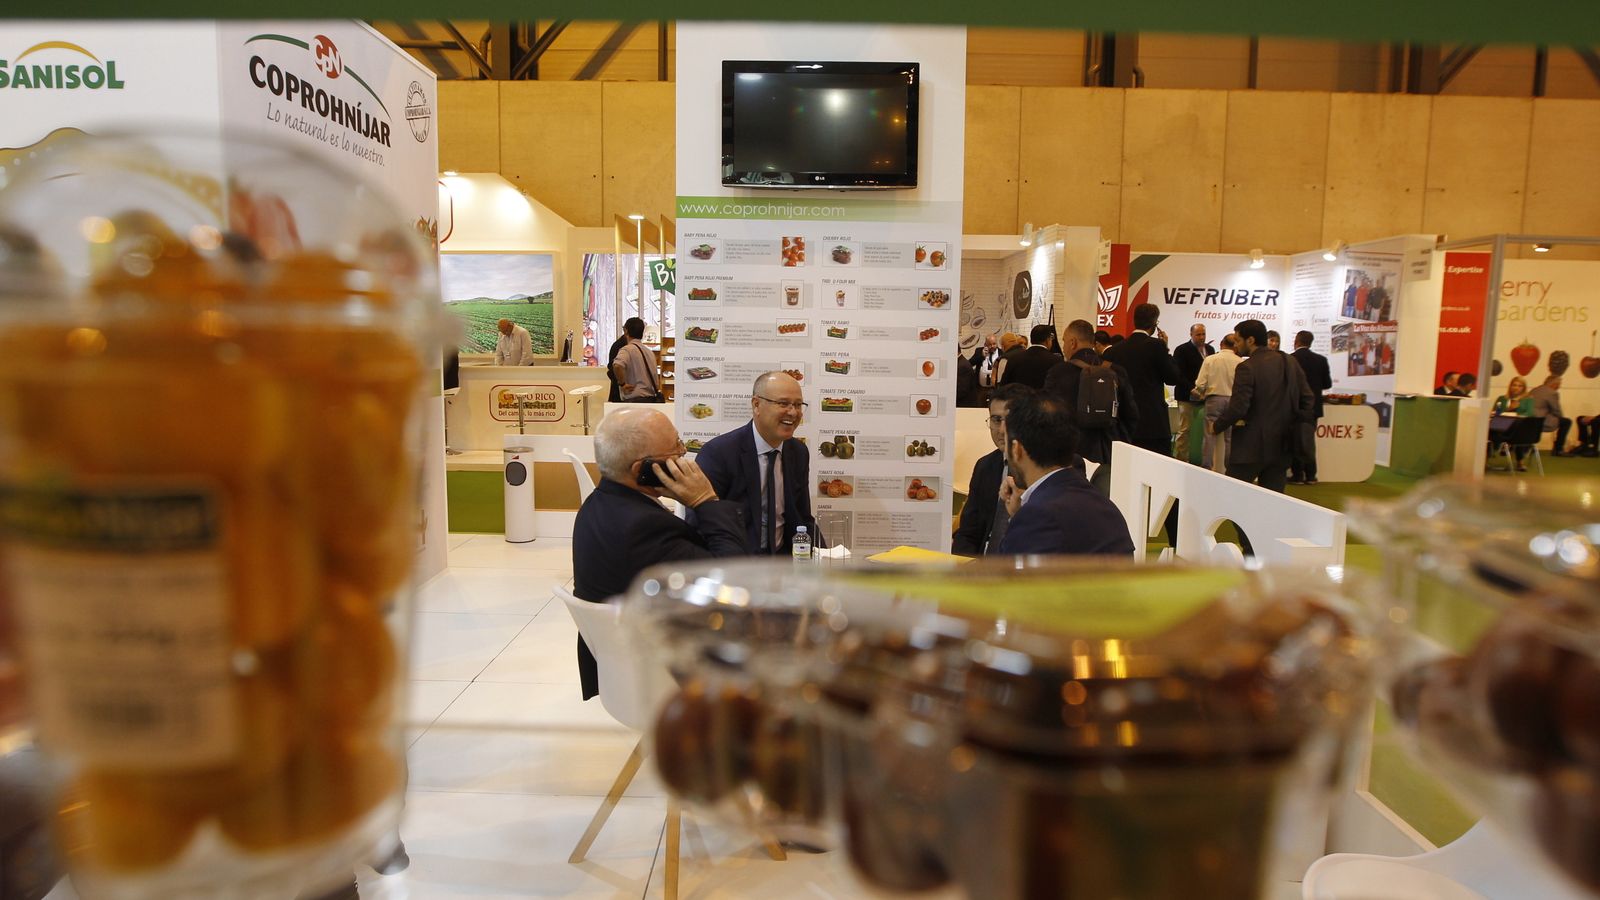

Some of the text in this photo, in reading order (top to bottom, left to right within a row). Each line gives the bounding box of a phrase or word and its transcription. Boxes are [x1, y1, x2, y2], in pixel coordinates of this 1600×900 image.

[0, 60, 125, 89] SANISOL
[249, 55, 391, 148] COPROHNÍJAR
[267, 101, 281, 122] Lo
[285, 112, 328, 142] natural
[330, 133, 339, 148] es
[341, 132, 349, 151] lo
[679, 202, 845, 218] www.coprohnijar.com
[1163, 287, 1279, 306] VEFRUBER
[1194, 310, 1277, 320] frutas y hortalizas
[1316, 425, 1352, 438] ONEX
